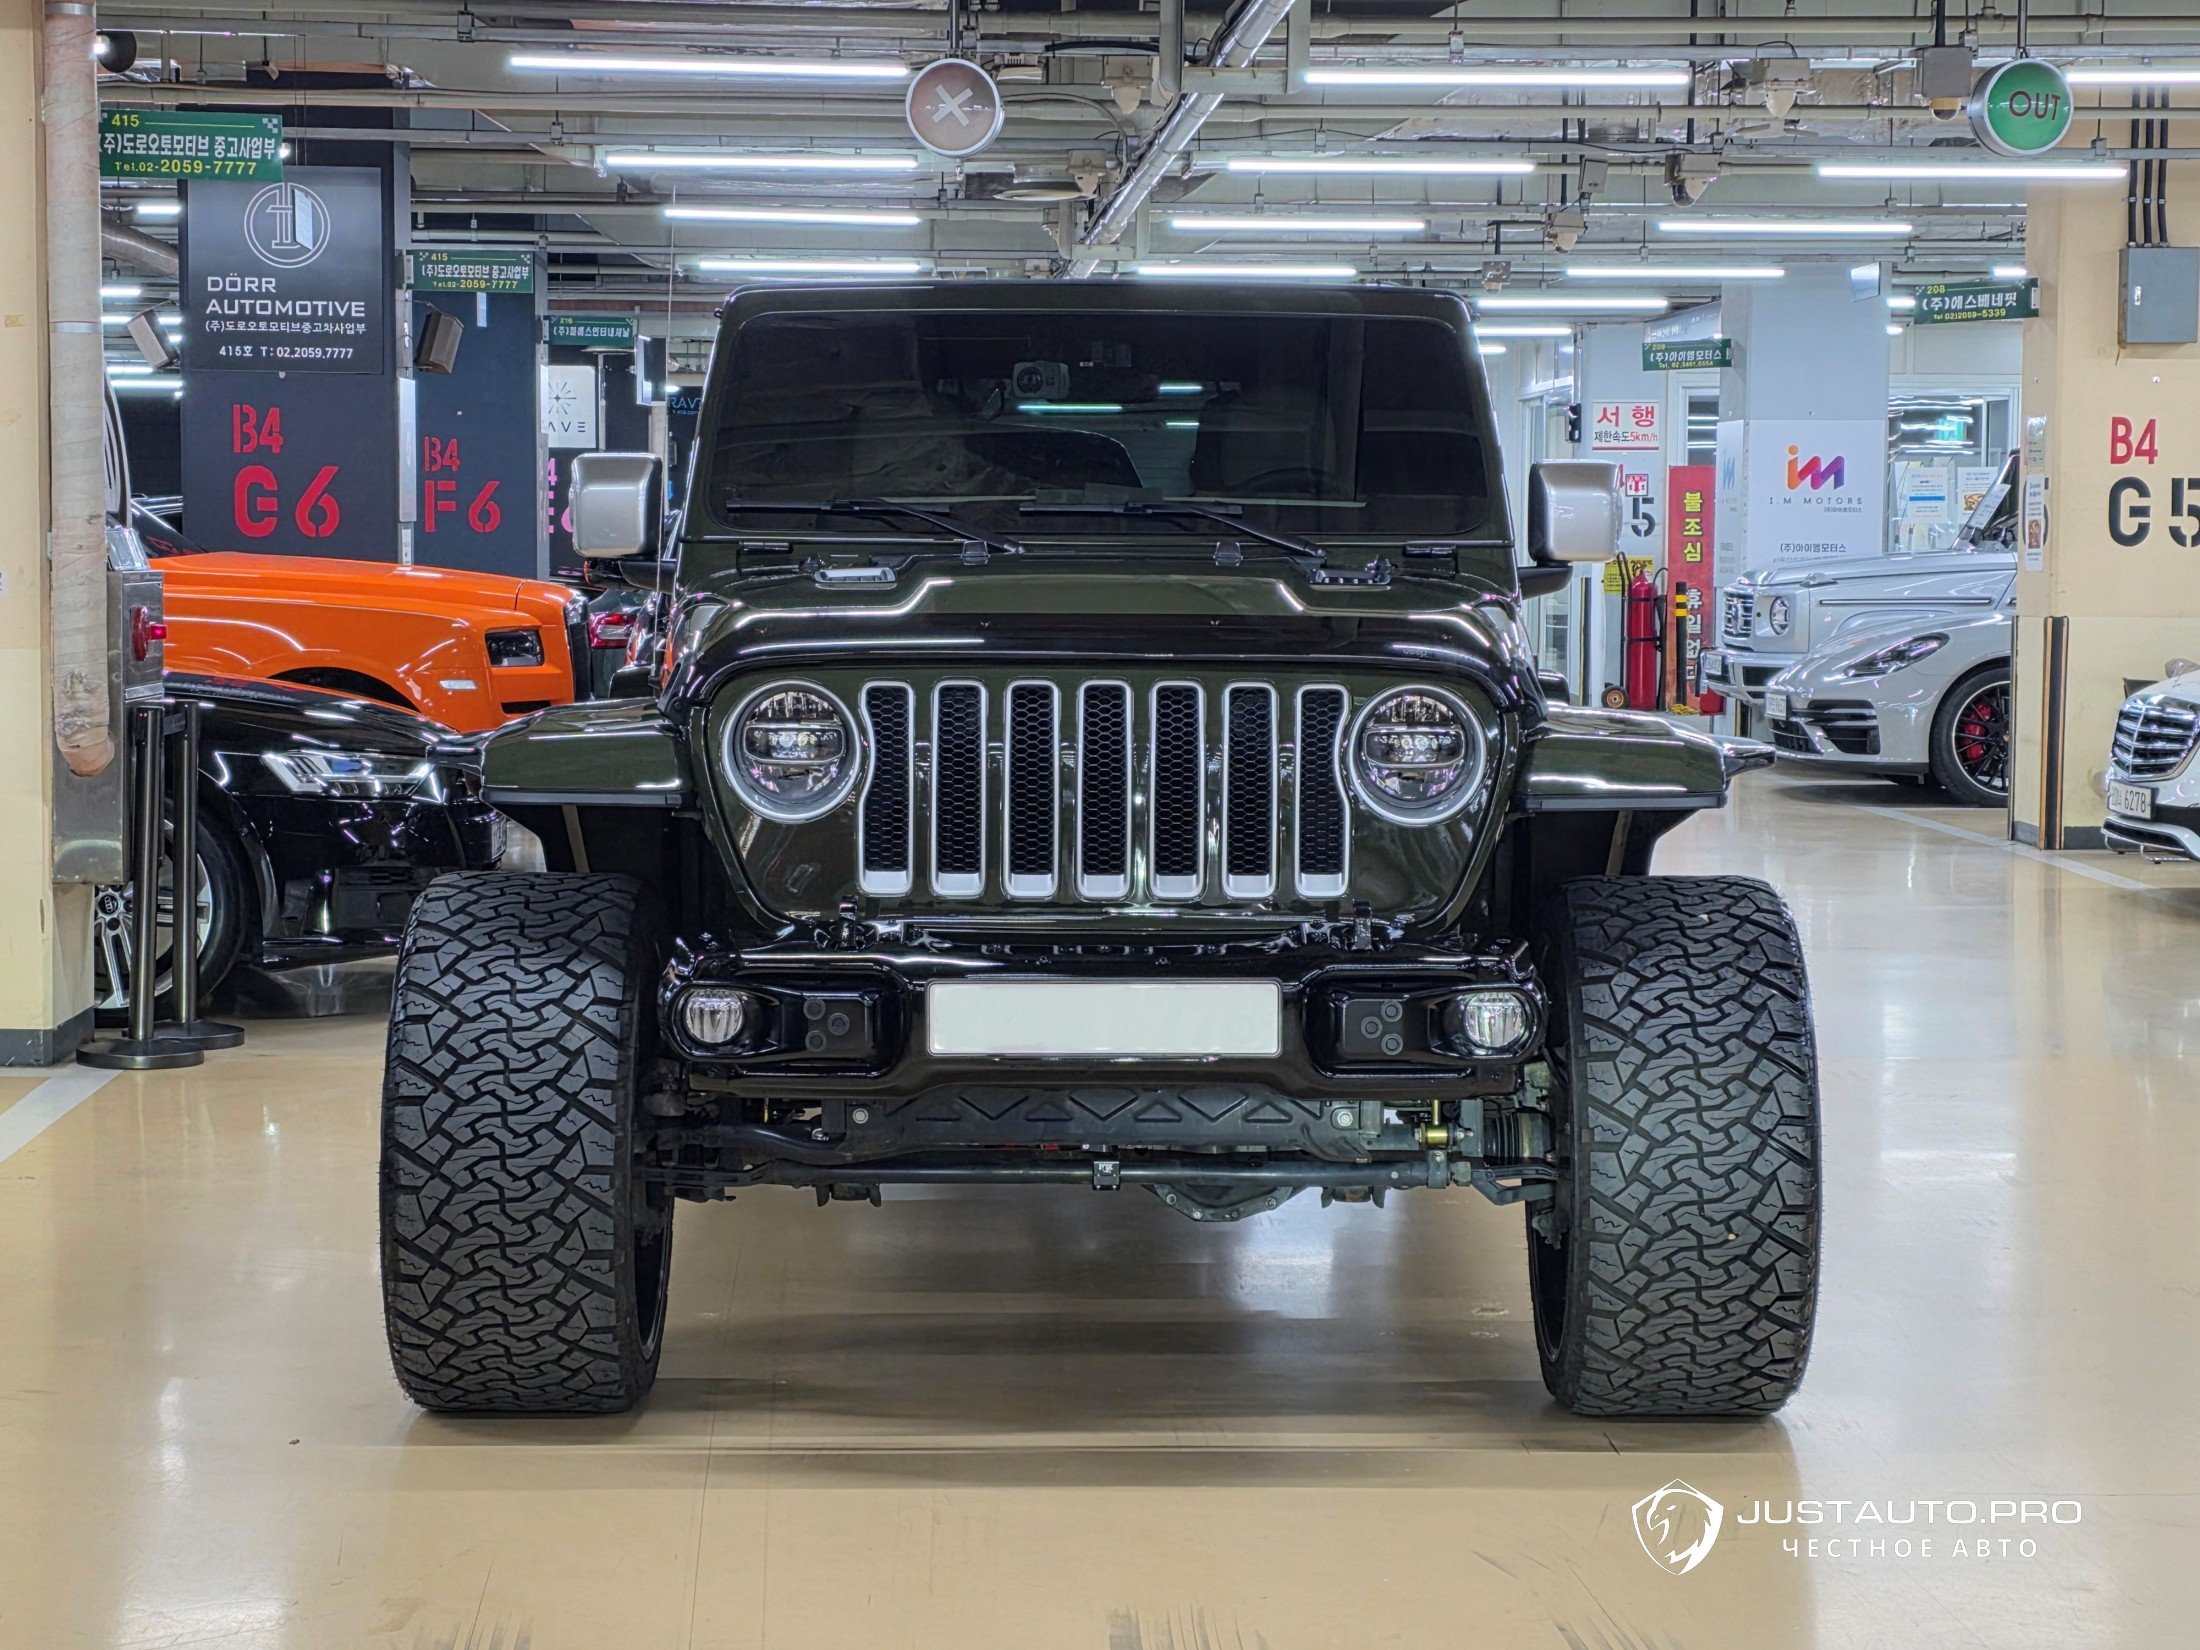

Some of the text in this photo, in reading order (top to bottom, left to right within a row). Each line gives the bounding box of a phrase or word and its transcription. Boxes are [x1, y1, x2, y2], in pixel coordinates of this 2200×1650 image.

[2009, 90, 2061, 121] OUT
[111, 114, 140, 128] 415
[214, 135, 276, 160] 중고사업부
[431, 252, 449, 262] 415
[207, 273, 277, 292] DÖRR
[205, 299, 366, 317] AUTOMOTIVE
[1922, 292, 2017, 311] (주)에스베네핏
[219, 345, 253, 357] 415호
[233, 404, 283, 454] B4
[2110, 416, 2159, 465] B4
[424, 436, 460, 472] B4
[234, 465, 340, 538] G 6
[424, 480, 457, 533] F
[468, 480, 501, 533] 6
[1803, 497, 1863, 505] MOTORS
[2108, 476, 2152, 547] G
[2168, 477, 2200, 548] 5
[1631, 497, 1656, 537] 5
[1683, 491, 1703, 563] 불조심
[1780, 543, 1847, 553] (주)아이엠모터스
